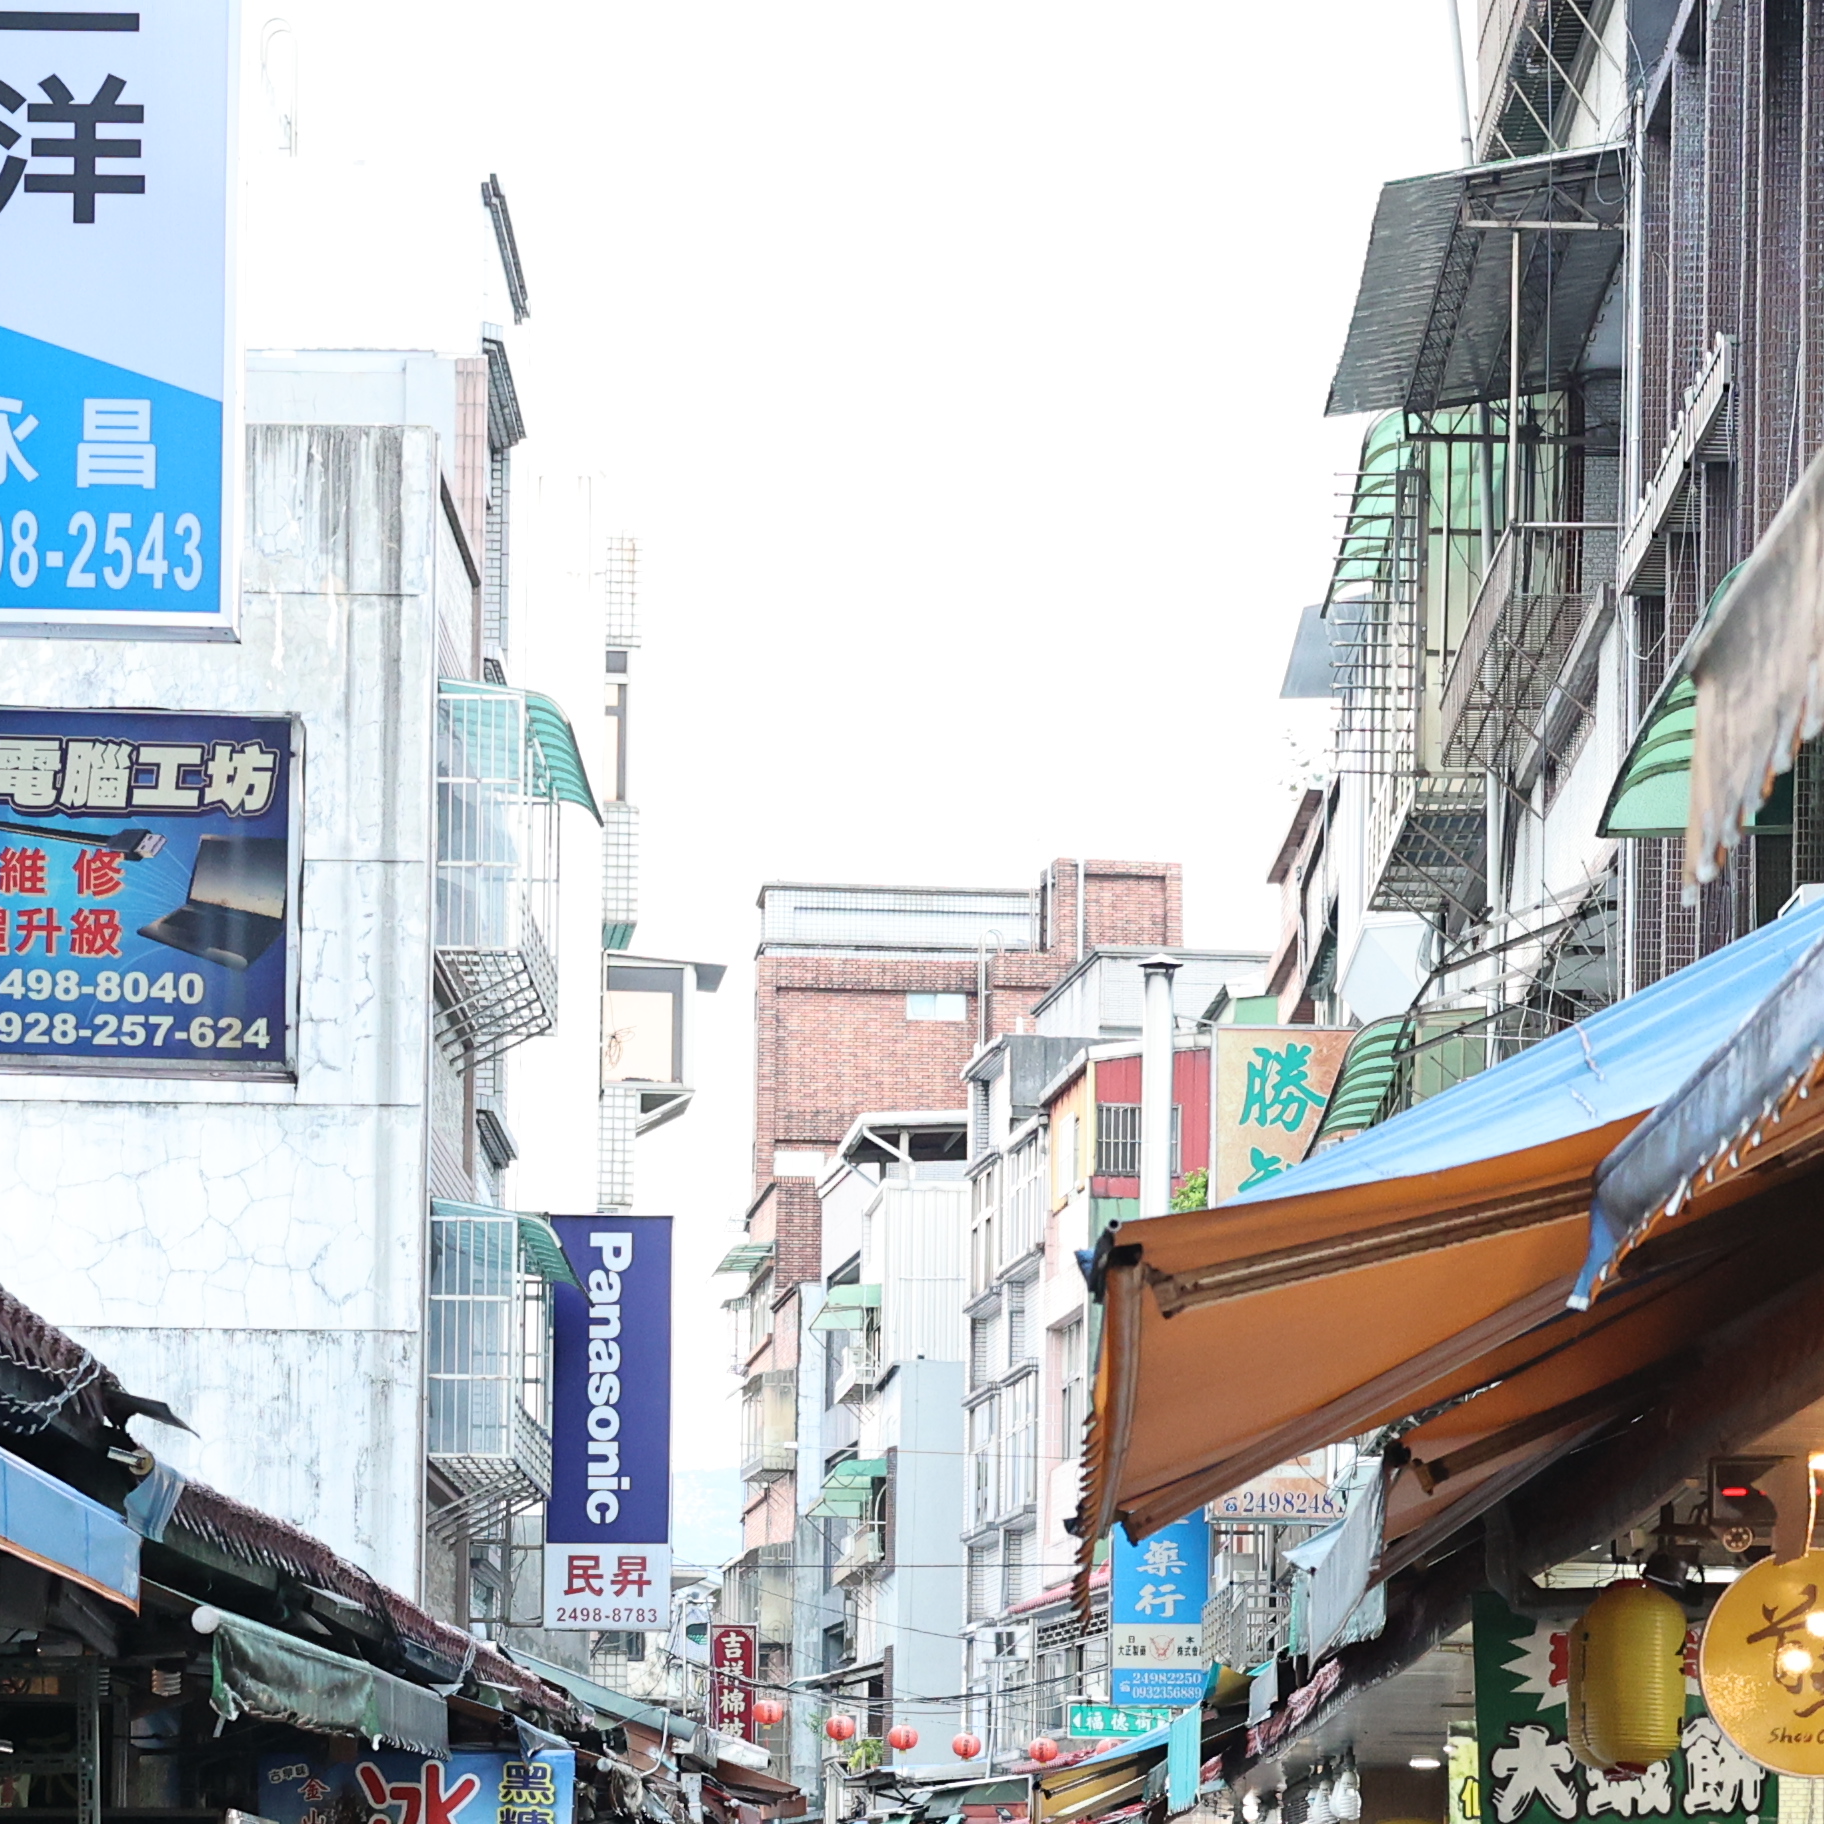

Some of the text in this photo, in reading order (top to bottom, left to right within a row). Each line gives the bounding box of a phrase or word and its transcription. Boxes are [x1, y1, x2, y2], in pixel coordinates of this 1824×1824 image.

[586, 1230, 633, 1525] Panasonic
[562, 1555, 651, 1598] 民昇
[1135, 1520, 1190, 1618] 藥行
[556, 1607, 658, 1624] 2498-8783
[720, 1632, 746, 1740] 吉祥棉被
[1132, 1672, 1202, 1685] 24982250
[1132, 1686, 1203, 1699] 0932356889
[1086, 1710, 1154, 1733] 福德街
